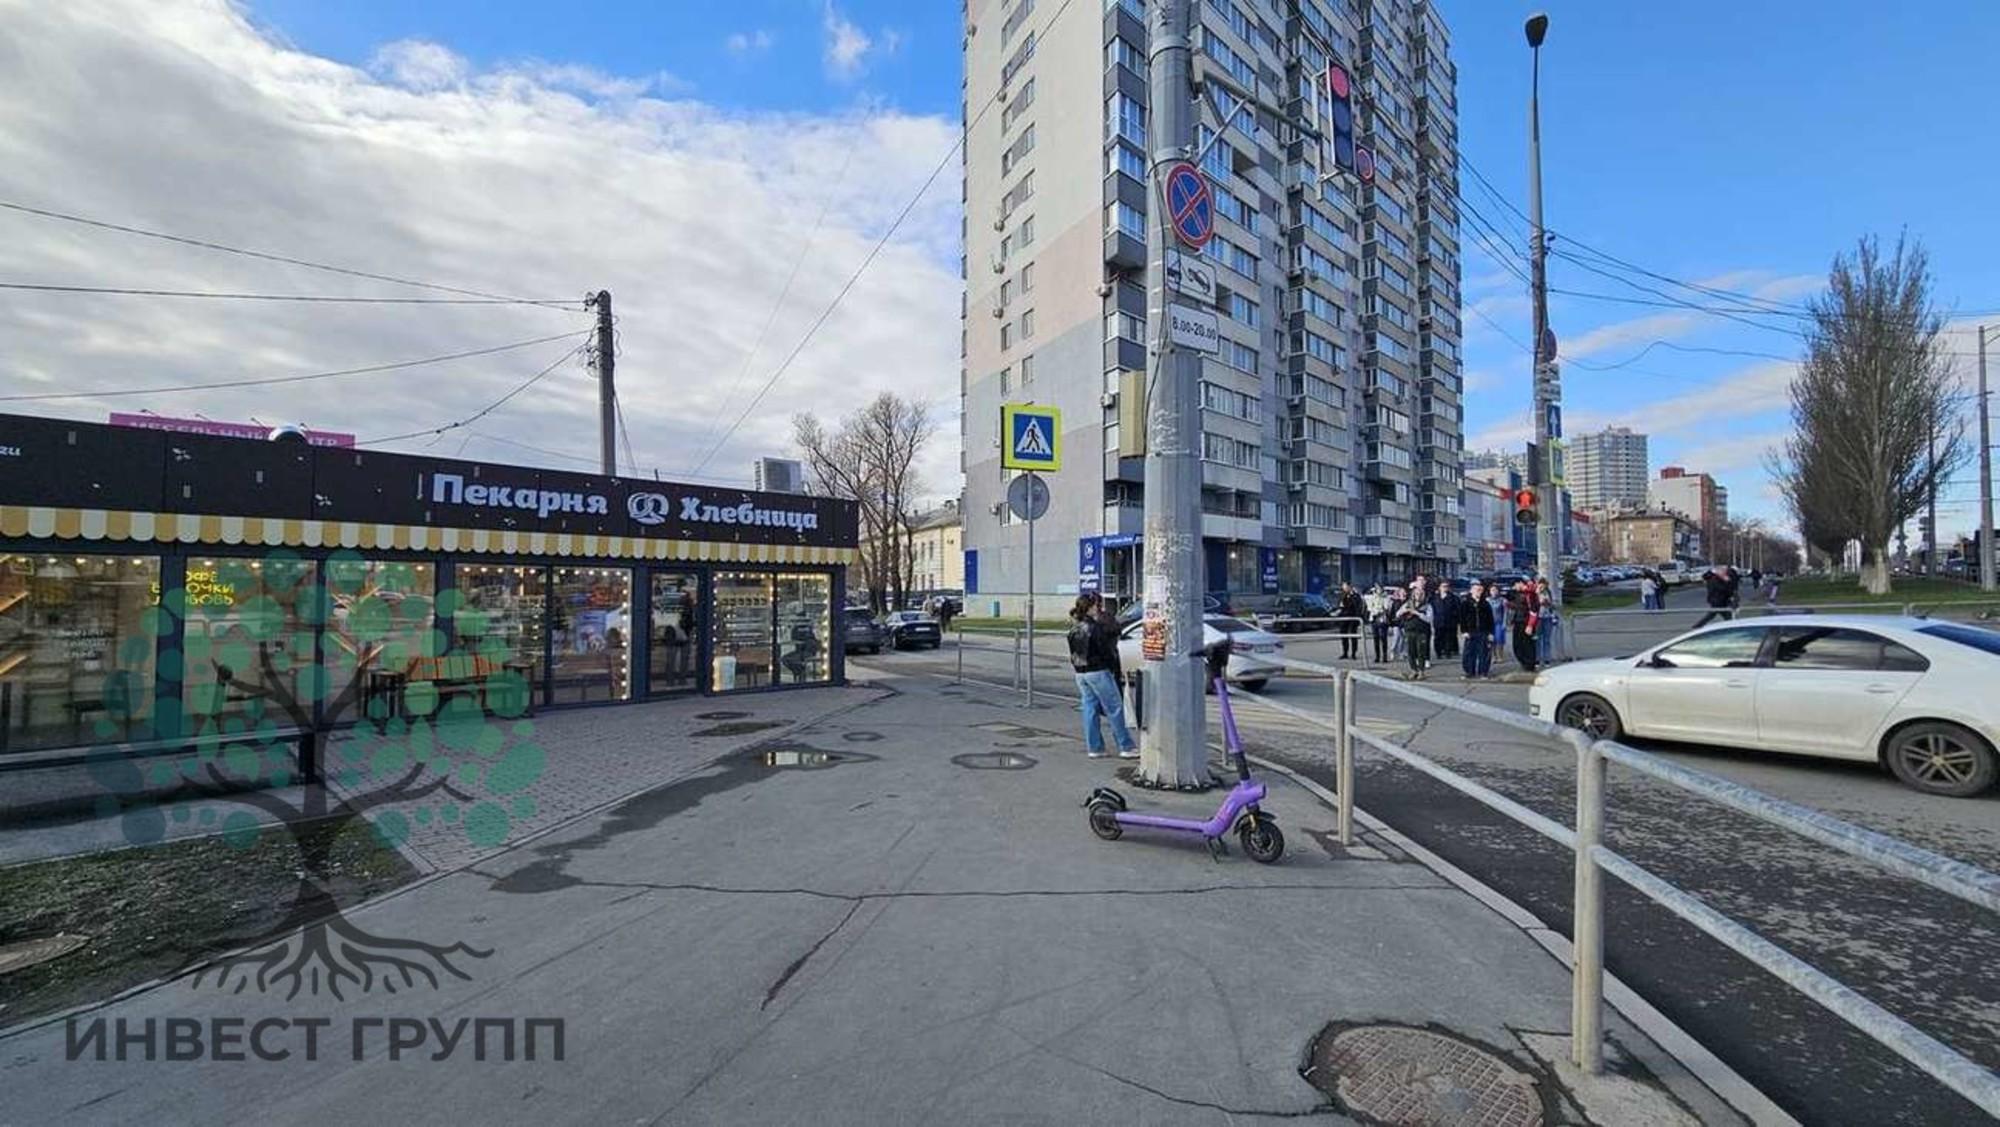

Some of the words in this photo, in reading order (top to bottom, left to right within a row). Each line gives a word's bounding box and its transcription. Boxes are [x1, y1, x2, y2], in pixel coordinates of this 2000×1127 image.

[1172, 315, 1216, 340] 8.00-20.00
[432, 473, 608, 518] Пекарня
[679, 496, 819, 533] Хлебница
